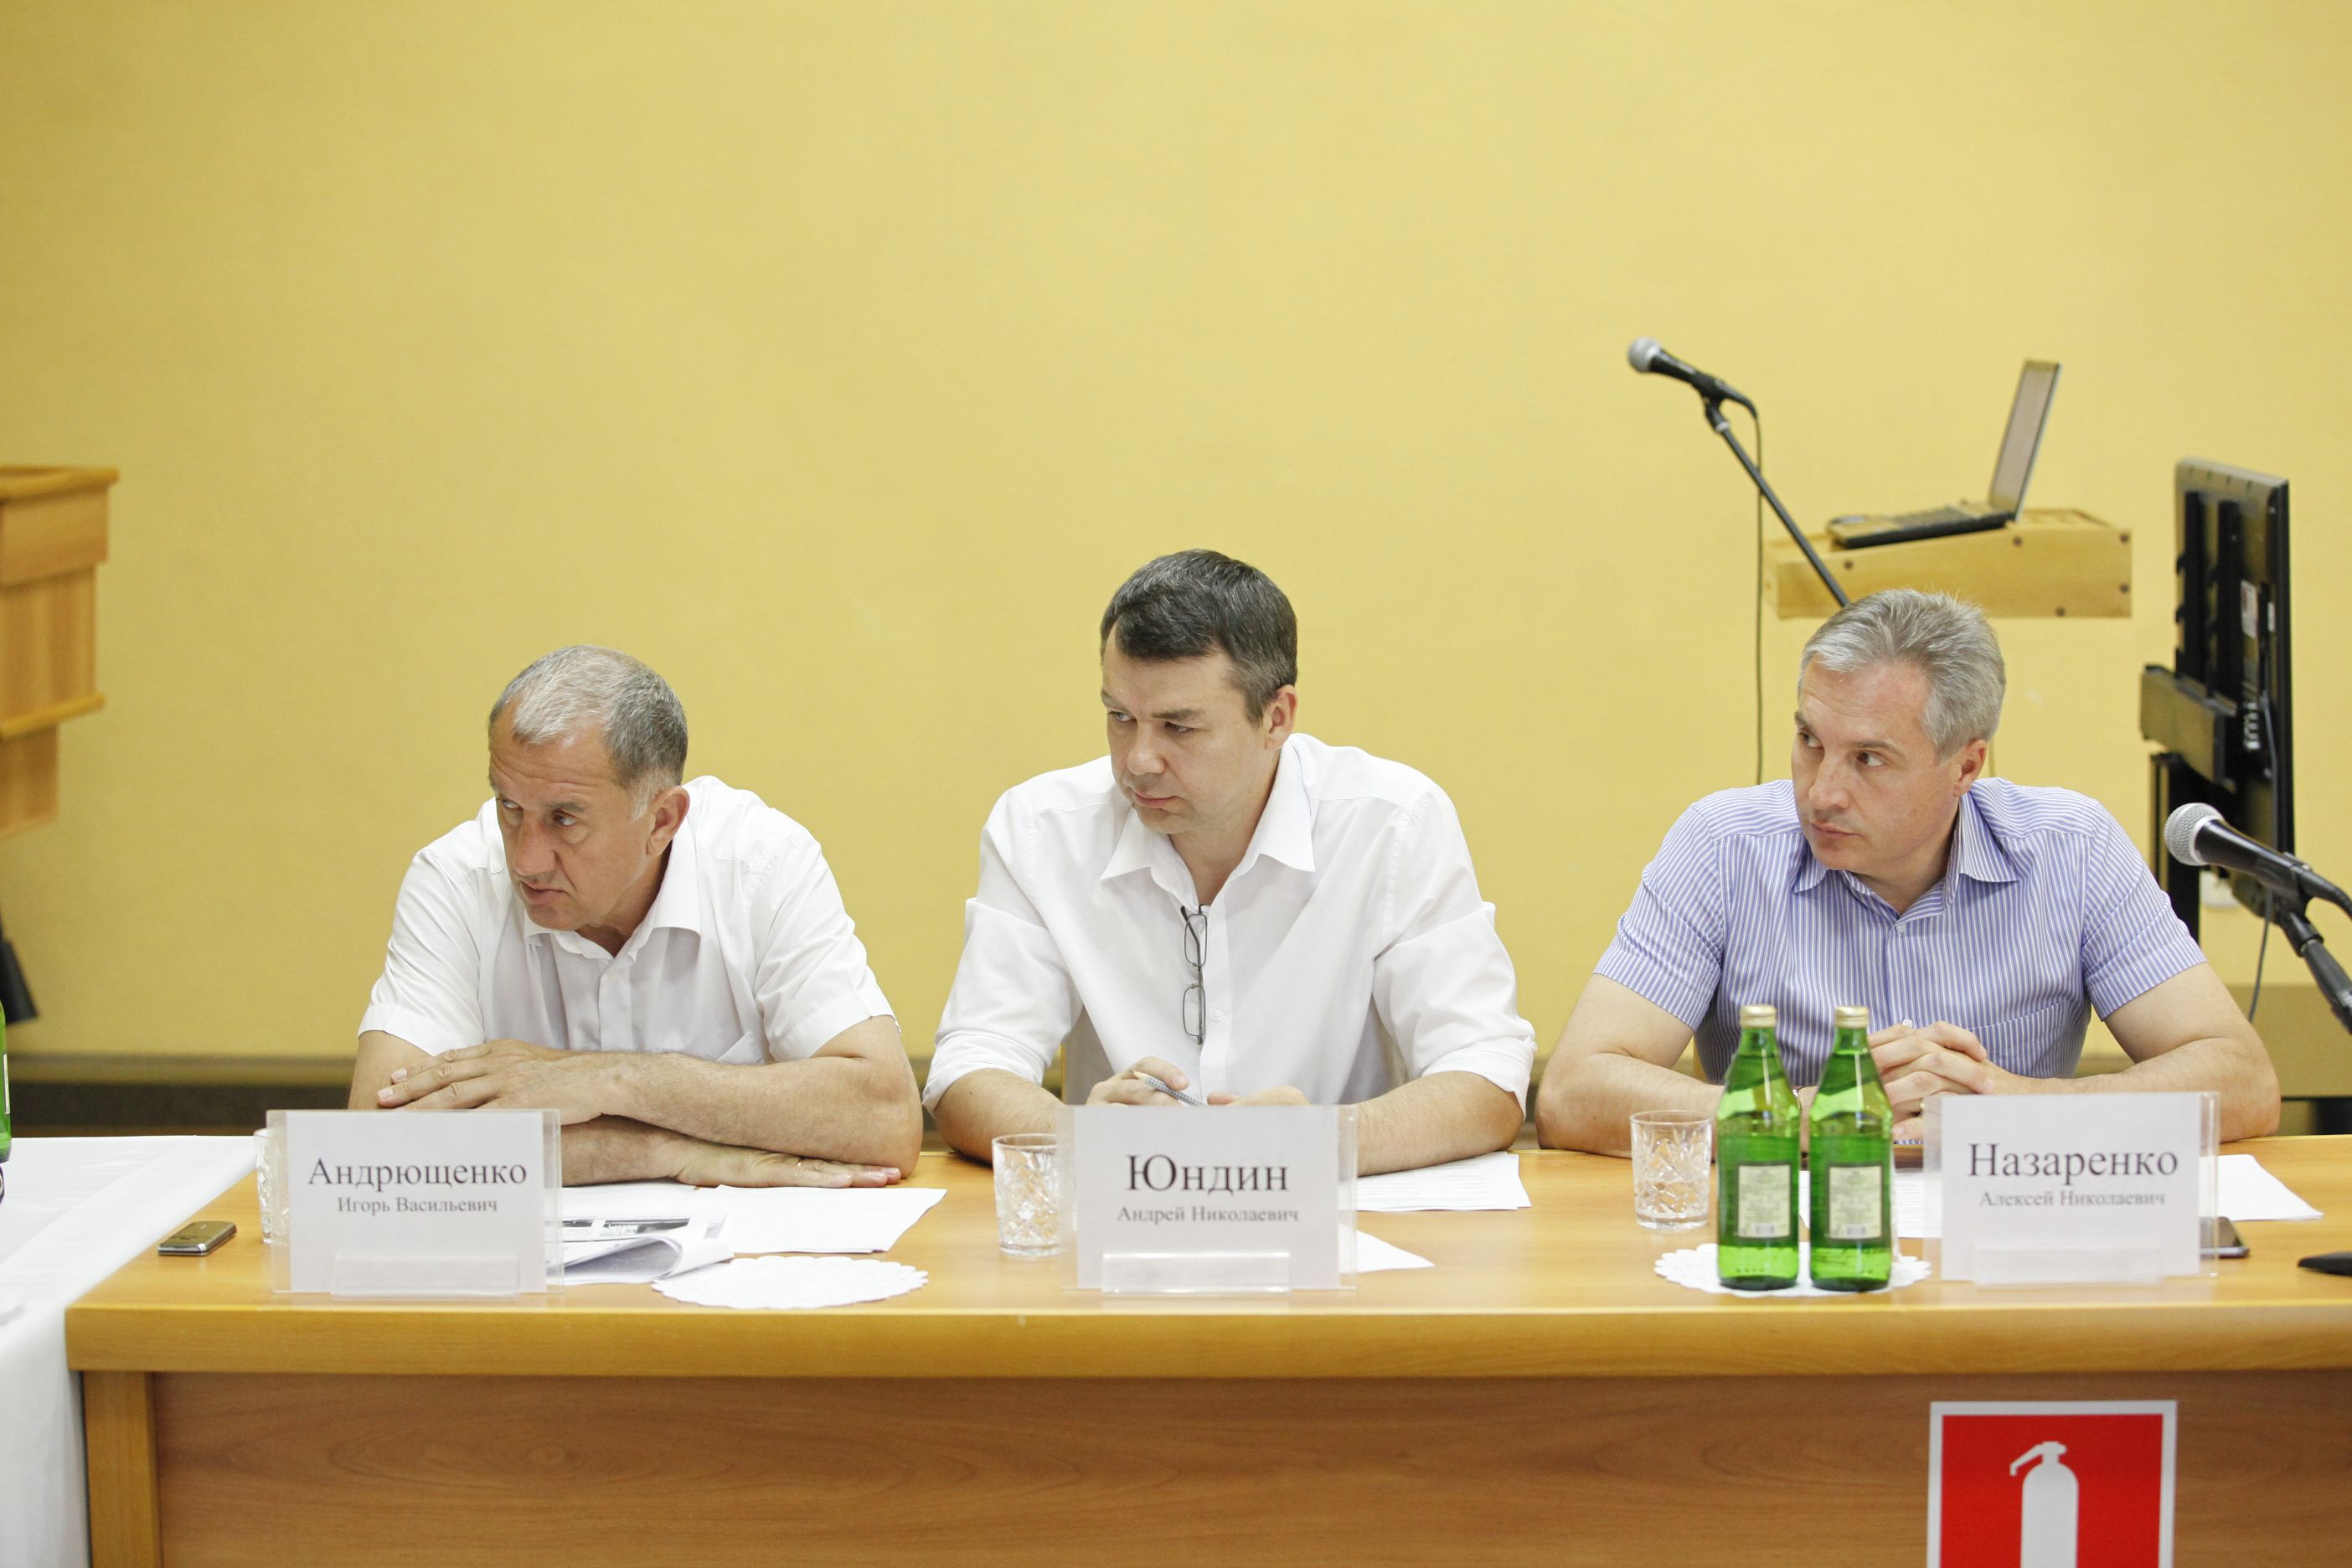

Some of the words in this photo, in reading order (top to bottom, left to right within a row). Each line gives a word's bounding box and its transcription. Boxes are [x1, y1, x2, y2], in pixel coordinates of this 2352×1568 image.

[307, 1158, 528, 1193] Андрющенко
[1126, 1153, 1289, 1195] Юндин
[1967, 1142, 2179, 1186] Назаренко
[338, 1196, 391, 1216] Игорь
[396, 1196, 498, 1213] Васильевич
[1978, 1190, 2054, 1207] Алексей
[2059, 1189, 2165, 1206] Николаевич
[1117, 1205, 1185, 1225] Андрей
[1192, 1205, 1299, 1223] Николаевич
